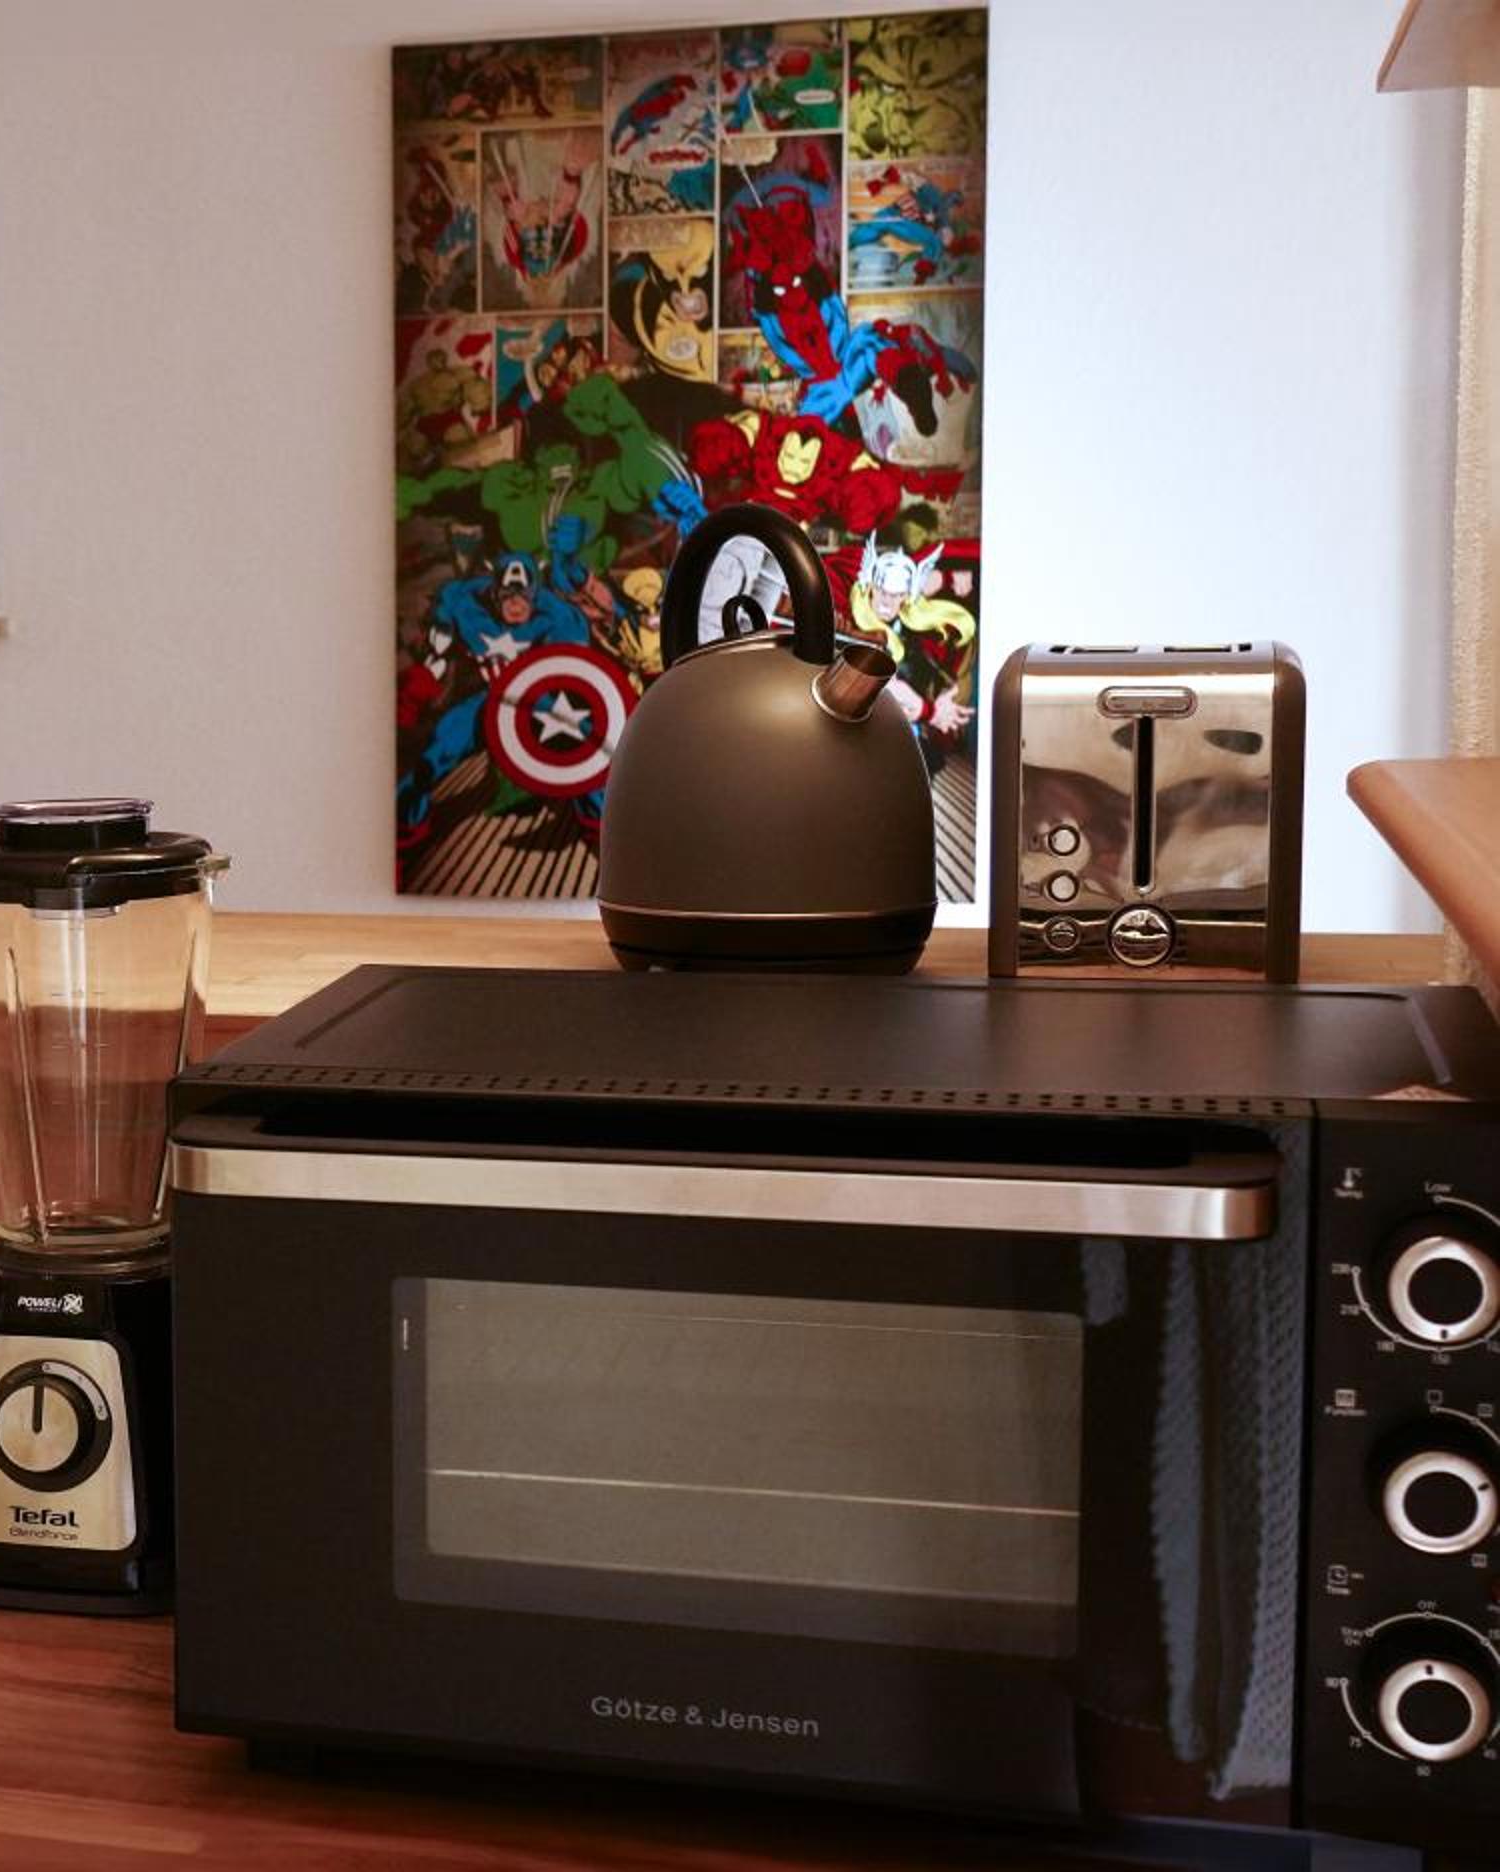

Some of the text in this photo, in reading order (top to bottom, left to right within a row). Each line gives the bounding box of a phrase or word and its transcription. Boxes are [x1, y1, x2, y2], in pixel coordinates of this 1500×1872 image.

[8, 1505, 79, 1528] Tefal
[8, 1526, 79, 1541] Blendforce
[591, 1696, 819, 1737] Götze & Jensen
